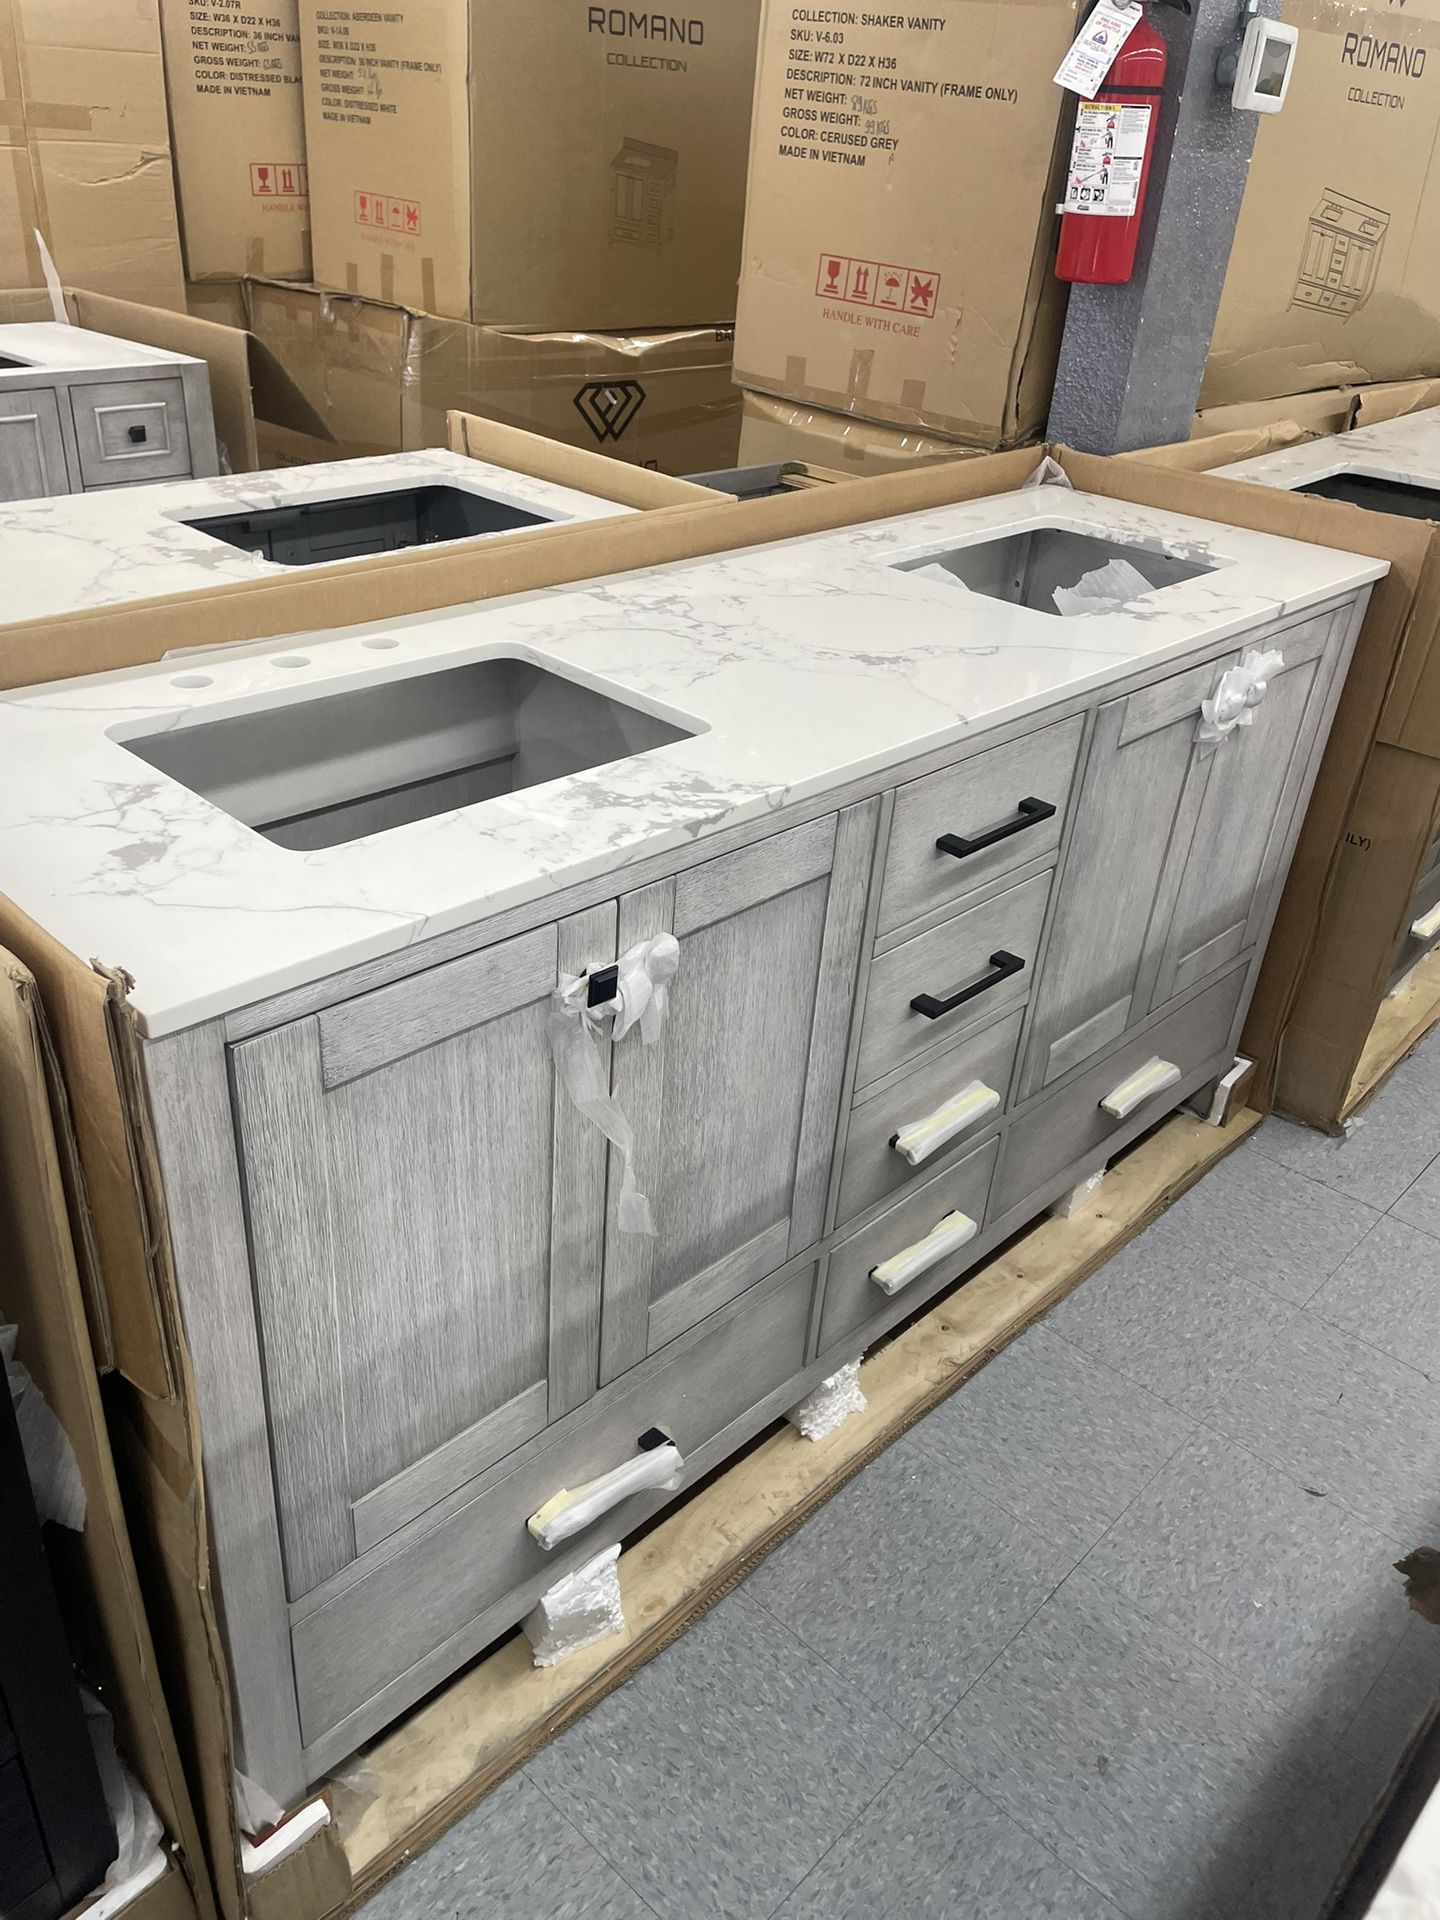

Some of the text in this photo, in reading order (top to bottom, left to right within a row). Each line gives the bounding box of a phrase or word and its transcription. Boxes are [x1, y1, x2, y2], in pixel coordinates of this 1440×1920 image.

[189, 11, 281, 28] SIZE: W36 X D22 X H36
[588, 7, 704, 46] ROMANO
[792, 9, 946, 31] COLLECTION: SHAKER VANITY
[191, 26, 250, 39] DESCRIPTION:
[253, 31, 262, 40] 36
[264, 31, 284, 42] INCH
[790, 29, 844, 44] SKU: V-6.03
[192, 41, 208, 50] NET
[210, 42, 246, 53] WEIGHT:
[1342, 32, 1426, 78] ROMANO
[194, 56, 224, 66] GROSS
[226, 57, 260, 68] WEIGHT:
[606, 53, 688, 72] COLLECTION
[788, 49, 897, 70] SIZE: W72 X D22 X H36
[195, 70, 228, 80] COLOR:
[230, 72, 282, 83] DISTRESSED
[786, 68, 1018, 104] DESCRIPTION: 72 INCH VANITY (FRAME ONLY)
[196, 84, 271, 96] MADE IN VIETNAM
[784, 88, 847, 105] NET WEIGHT:
[1348, 87, 1405, 109] COLLECTION
[782, 107, 861, 126] GROSS WEIGHT:
[780, 126, 899, 150] COLOR: CERUSED GREY
[778, 144, 866, 166] MADE IN VIETNAM
[822, 308, 920, 338] HANDLE WITH CARE
